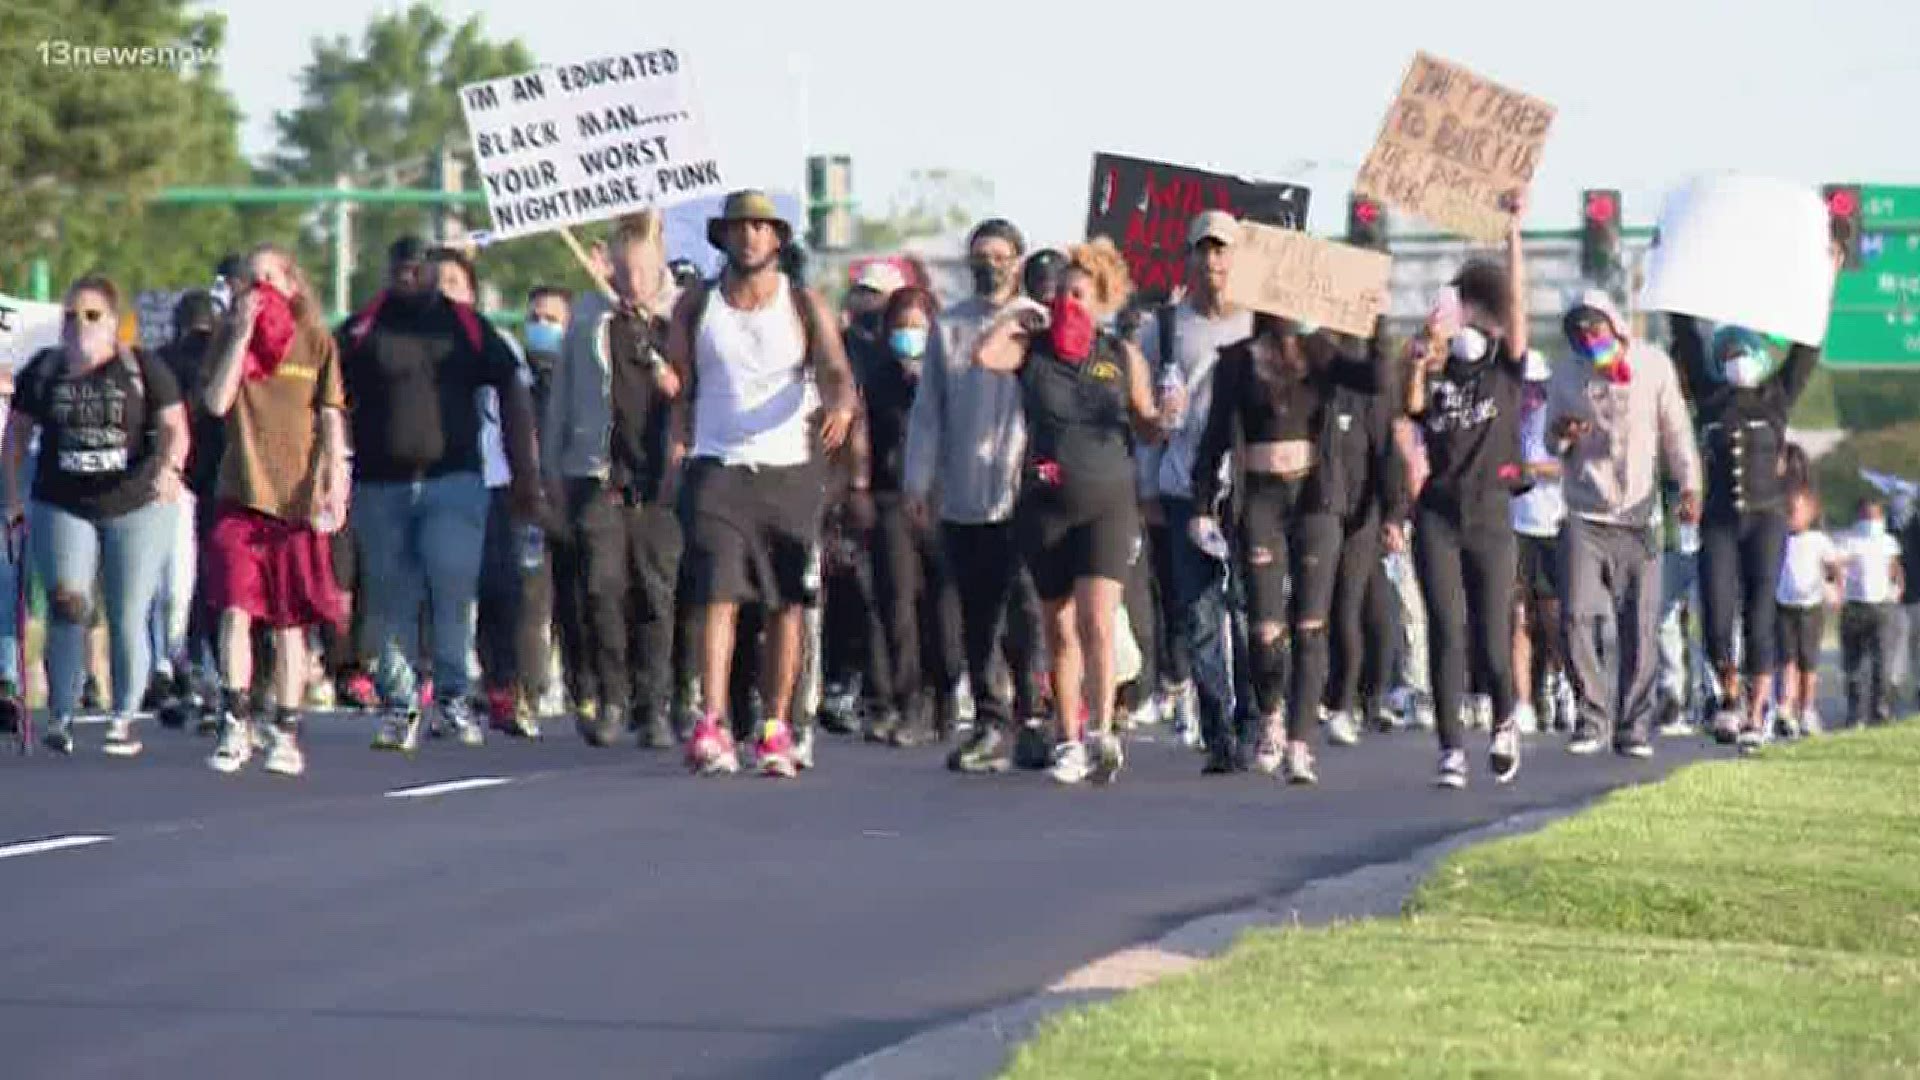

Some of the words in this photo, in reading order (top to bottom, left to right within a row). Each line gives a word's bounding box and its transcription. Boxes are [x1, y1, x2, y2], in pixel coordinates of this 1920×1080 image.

[513, 75, 546, 101] AN
[556, 49, 679, 91] EDUCATED
[477, 121, 560, 158] BLACK
[487, 160, 557, 197] YOUR
[579, 136, 669, 175] WORST
[657, 159, 721, 193] PUNK
